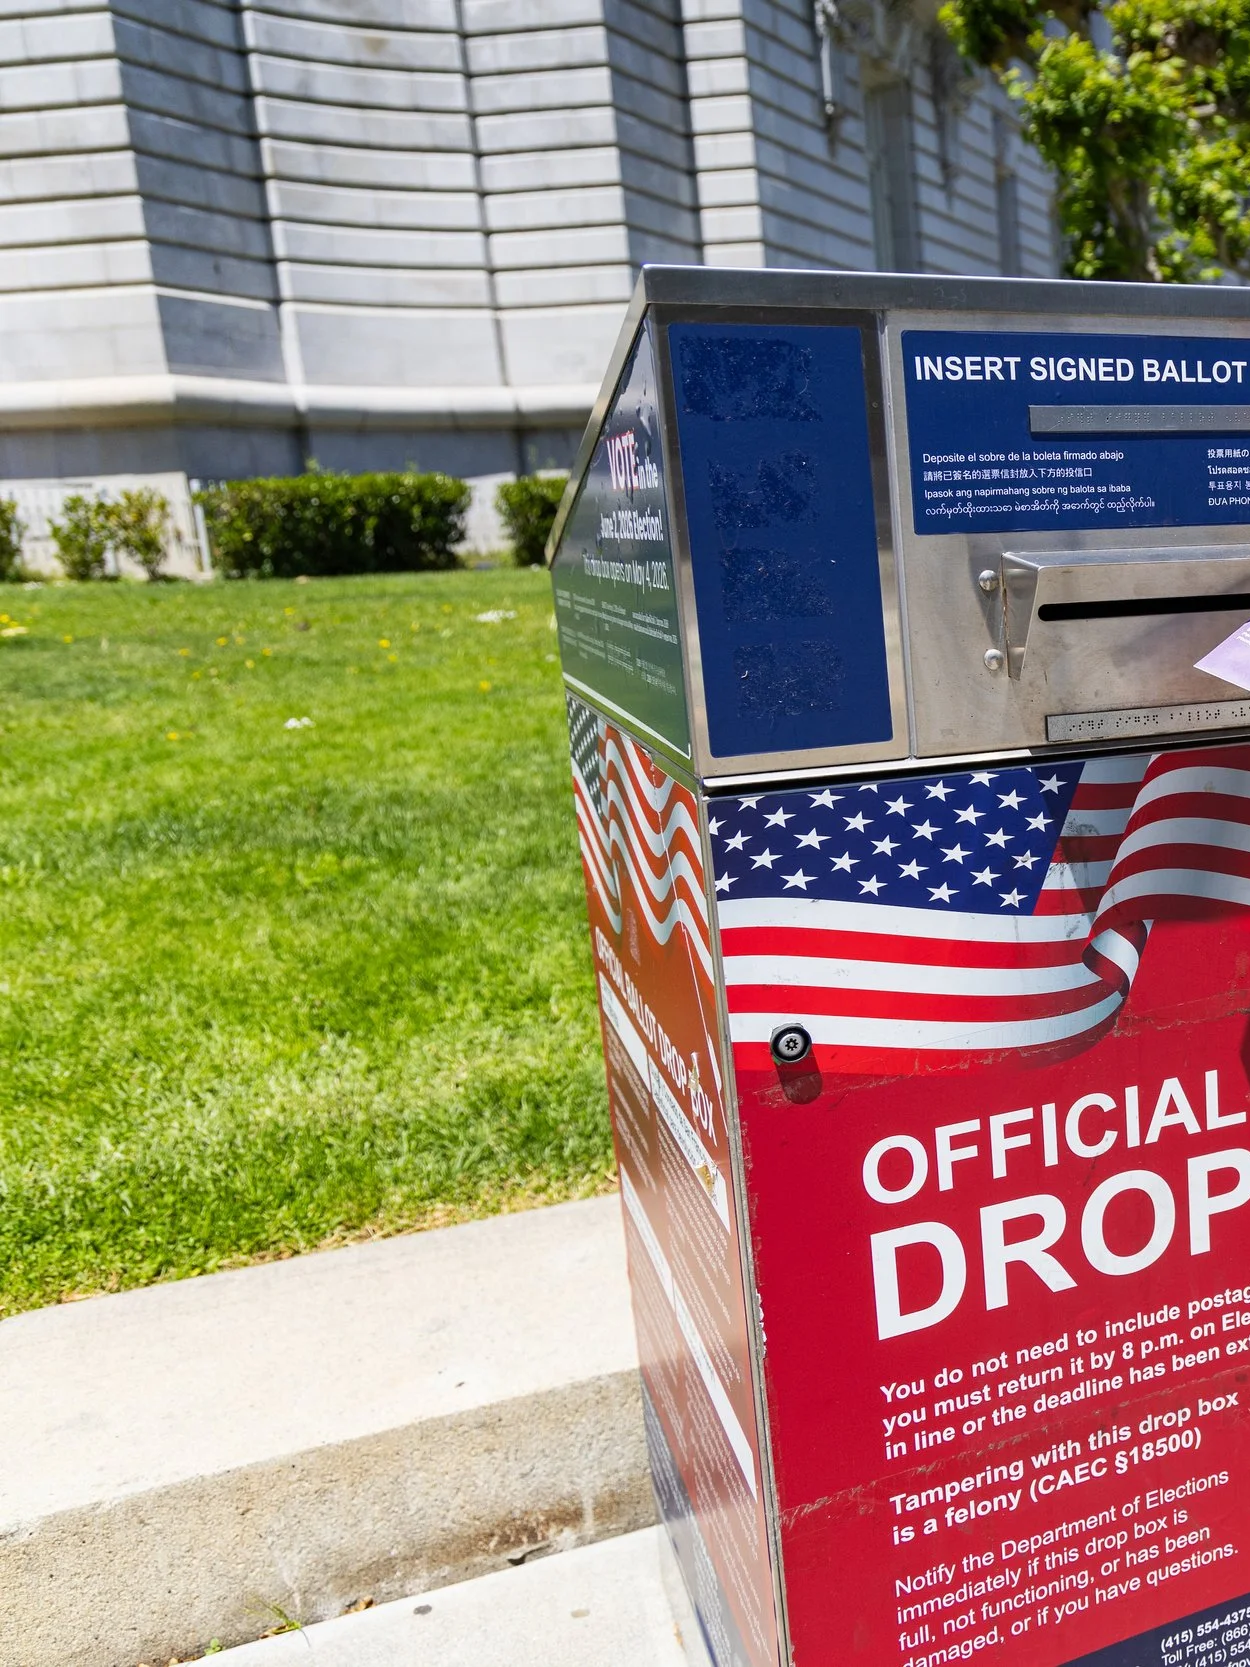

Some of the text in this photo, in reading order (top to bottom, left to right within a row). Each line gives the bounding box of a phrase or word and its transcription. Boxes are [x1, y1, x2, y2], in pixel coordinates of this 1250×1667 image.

[915, 356, 1020, 380] INSERT
[1030, 357, 1133, 381] SIGNED
[1143, 359, 1247, 383] BALLOT
[606, 432, 659, 490] VOTE in the
[923, 450, 1123, 464] Deposite el sobre de la boleta firmado abajo
[925, 489, 953, 499] Ipasok
[956, 490, 971, 498] ang
[974, 487, 1029, 497] napirmahang
[1032, 486, 1055, 494] sobre
[1057, 487, 1067, 495] ng
[1070, 485, 1094, 493] balota
[1109, 484, 1130, 492] ibaba
[1208, 480, 1241, 490] 투표용지
[595, 925, 627, 1001] OFFICIAL
[624, 971, 658, 1052] BALLOT
[657, 1022, 688, 1096] DROP
[691, 1082, 718, 1148] BOX
[863, 1070, 1246, 1204] OFFICIAL
[880, 1379, 925, 1402] You
[934, 1368, 963, 1388] do
[972, 1352, 1008, 1377] not
[1017, 1333, 1068, 1364] need
[1076, 1330, 1097, 1346] to
[1106, 1305, 1180, 1338] include
[883, 1407, 926, 1437] you
[934, 1384, 991, 1416] must
[998, 1367, 1063, 1397] return
[1071, 1357, 1084, 1375] it
[1091, 1351, 1115, 1370] by
[1122, 1342, 1134, 1359] 8
[1141, 1333, 1183, 1359] p.m.
[1190, 1323, 1215, 1339] on
[886, 1442, 906, 1459] in
[915, 1427, 955, 1451] line
[963, 1416, 986, 1434] or
[992, 1405, 1026, 1426] the
[1034, 1376, 1123, 1413] deadline
[1130, 1363, 1165, 1384] has
[1172, 1347, 1219, 1371] been
[890, 1392, 1239, 1514] Tampering with this drop box
[893, 1427, 1201, 1545] is a felony (CAEC §18500)
[896, 1471, 1228, 1597] Notify the Department of Elections
[898, 1510, 1188, 1624] immediately if this drop box is
[899, 1527, 1210, 1650] full, not functioning, or has been
[903, 1542, 1240, 1667] damaged, or if you have questions.
[1161, 1629, 1193, 1653] (415)
[1161, 1649, 1182, 1666] Toll
[1185, 1637, 1217, 1658] Free:
